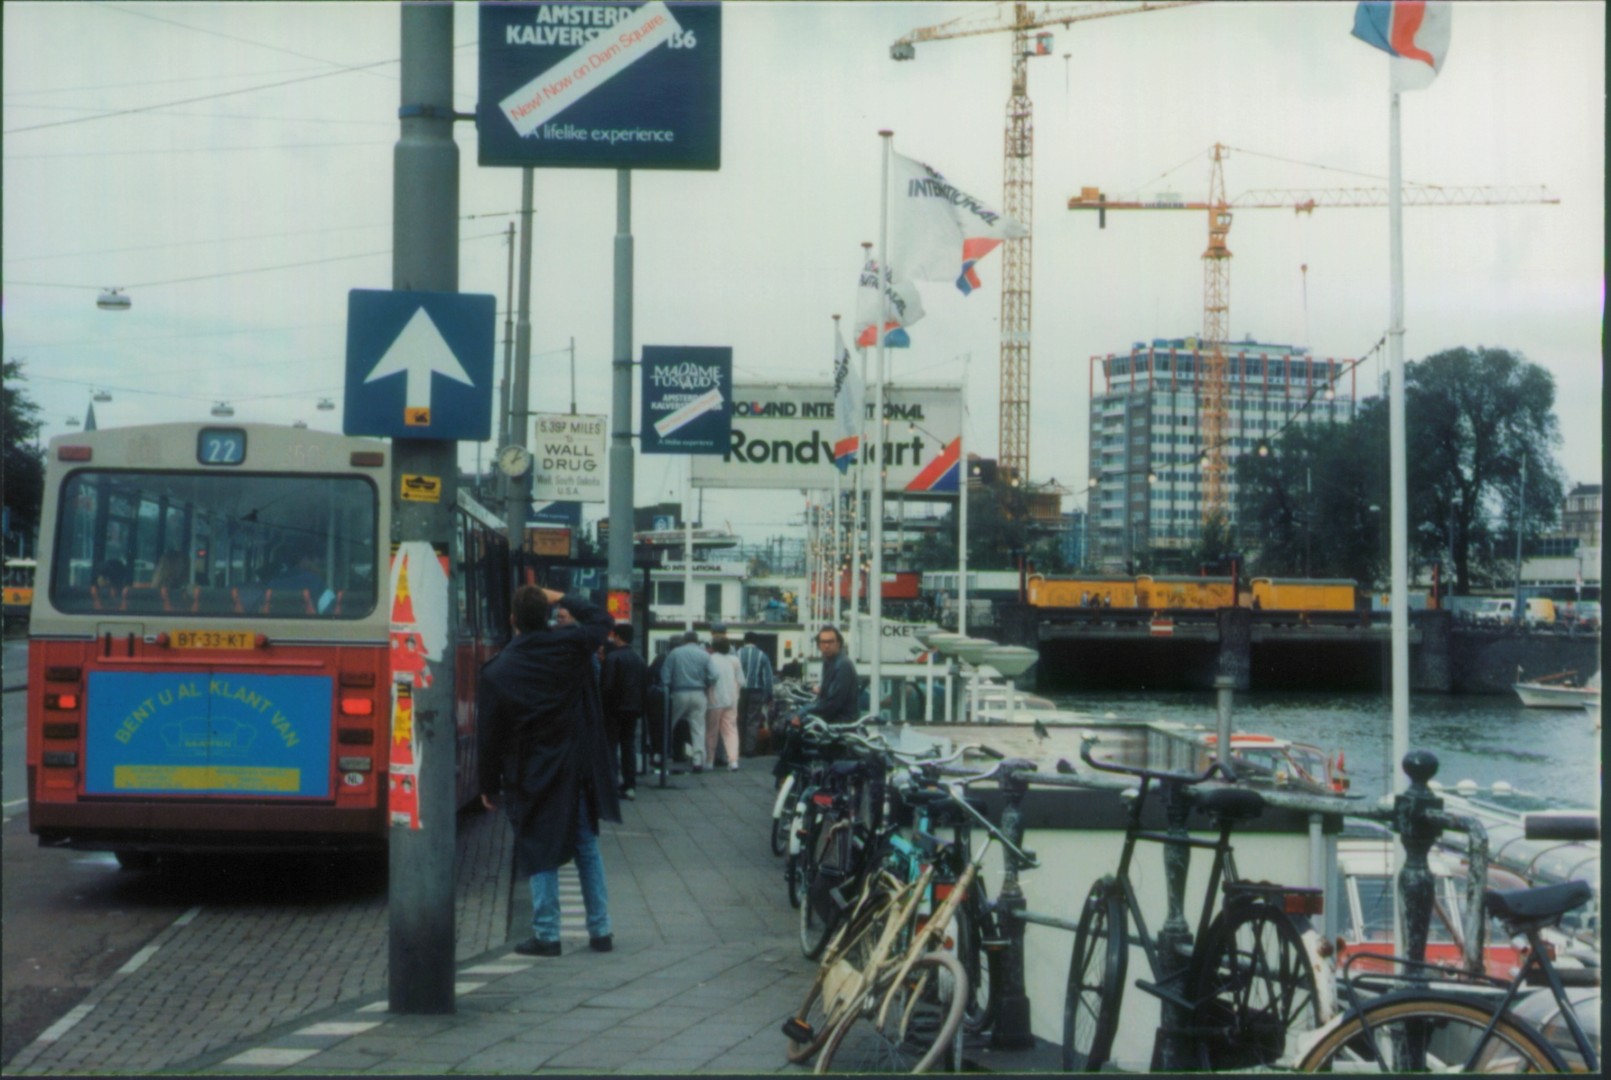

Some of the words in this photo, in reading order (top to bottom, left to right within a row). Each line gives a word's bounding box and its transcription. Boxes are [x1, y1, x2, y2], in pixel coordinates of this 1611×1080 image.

[536, 6, 635, 26] AMSTERD
[511, 94, 544, 121] New!
[542, 74, 573, 99] Now
[574, 64, 592, 81] on
[588, 43, 622, 69] Dam
[544, 124, 588, 141] lifelike
[590, 127, 674, 146] experience
[654, 362, 721, 378] MADAME
[570, 422, 601, 436] MILES
[208, 438, 237, 463] 22
[544, 444, 595, 457] WALL
[543, 458, 597, 472] DRUG
[177, 632, 248, 647] BT-33-KT
[115, 699, 158, 745] BENT
[158, 689, 174, 706] U
[177, 682, 202, 699] AL
[208, 679, 273, 714] KLANT
[270, 710, 301, 749] VAN
[346, 774, 361, 785] NL
